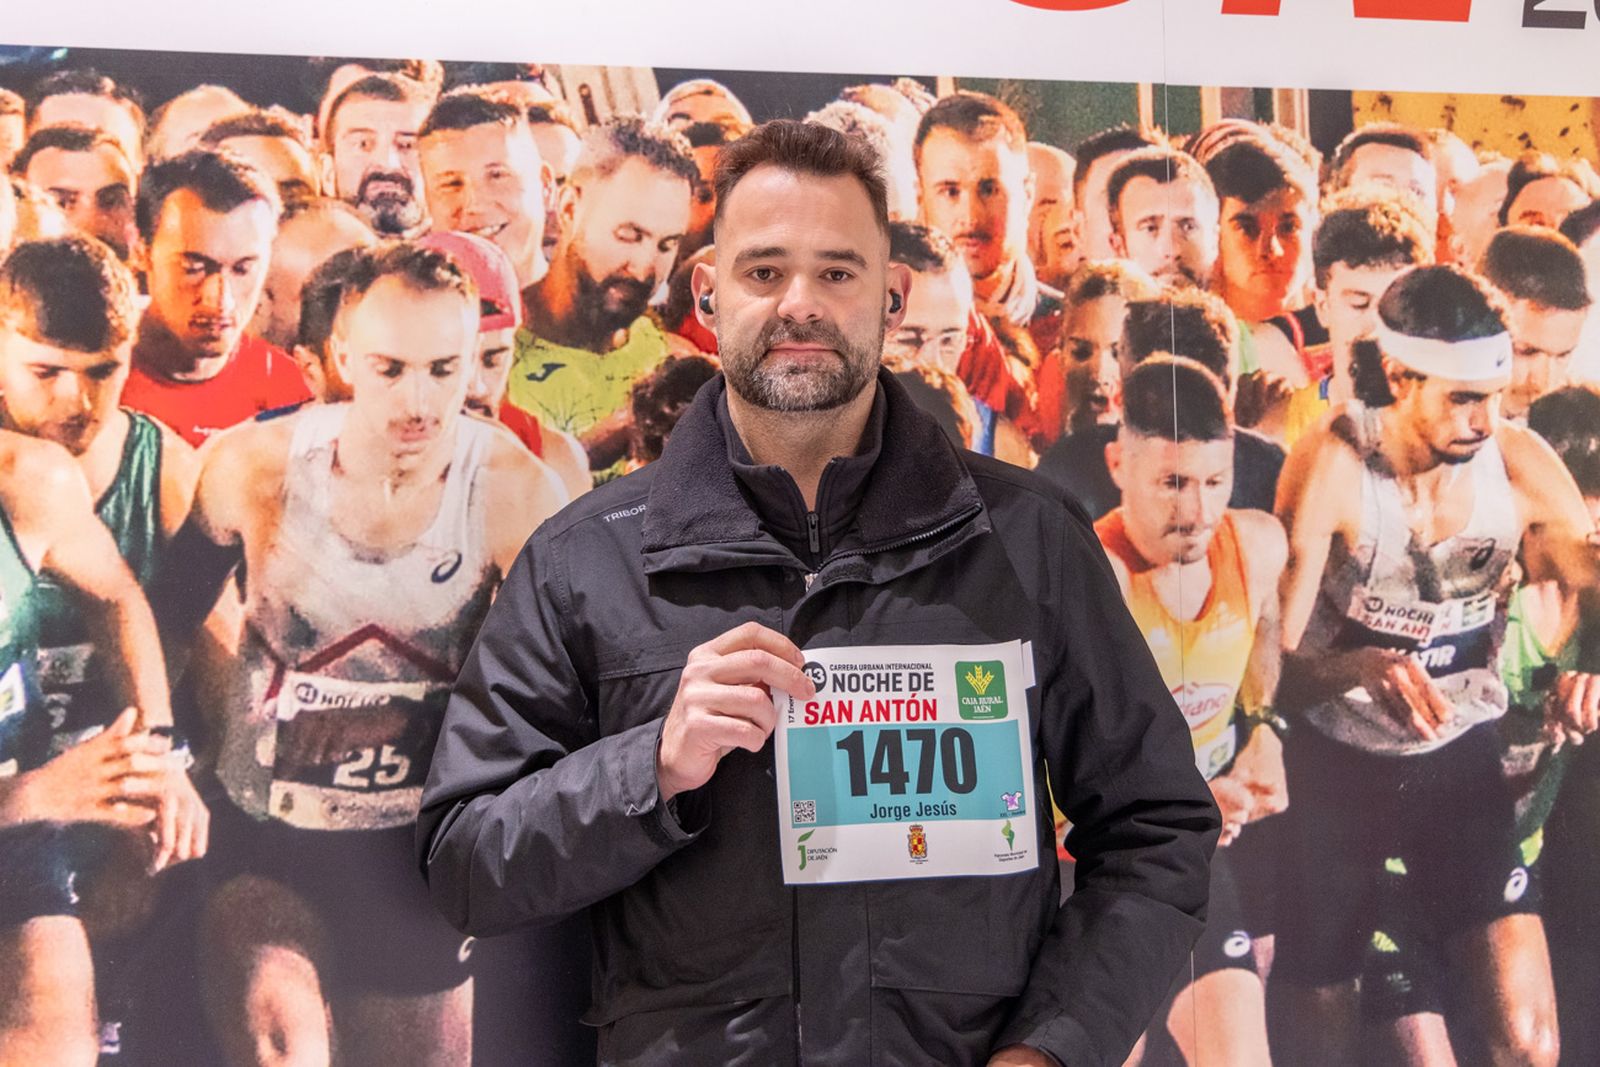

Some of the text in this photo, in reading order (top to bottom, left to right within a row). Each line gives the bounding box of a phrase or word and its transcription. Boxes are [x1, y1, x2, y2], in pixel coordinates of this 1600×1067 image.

[829, 662, 933, 671] CARRERA URBANA INTERNACIONAL
[832, 672, 934, 693] NOCHE DE
[804, 693, 937, 725] SAN ANTÓN
[333, 744, 411, 788] 25
[836, 727, 977, 797] 1470
[870, 801, 957, 821] Jorge Jesús
